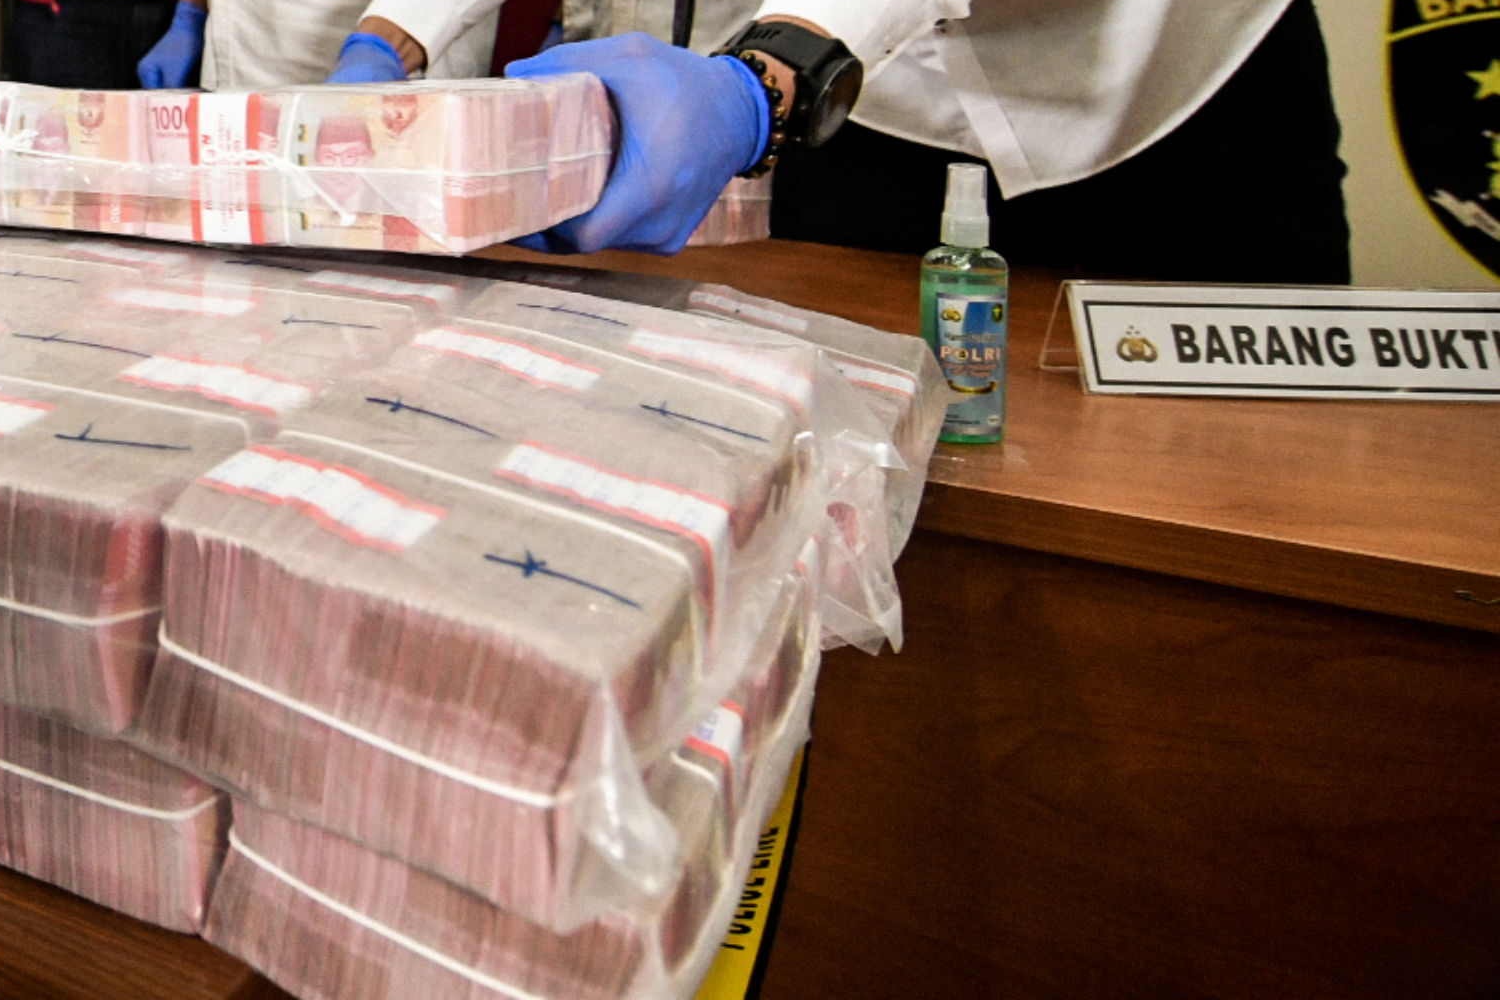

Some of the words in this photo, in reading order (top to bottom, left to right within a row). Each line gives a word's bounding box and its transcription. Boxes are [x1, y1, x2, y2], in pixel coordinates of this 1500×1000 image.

[151, 105, 190, 130] 100
[940, 345, 1001, 361] POLRI
[1171, 323, 1357, 367] BARANG
